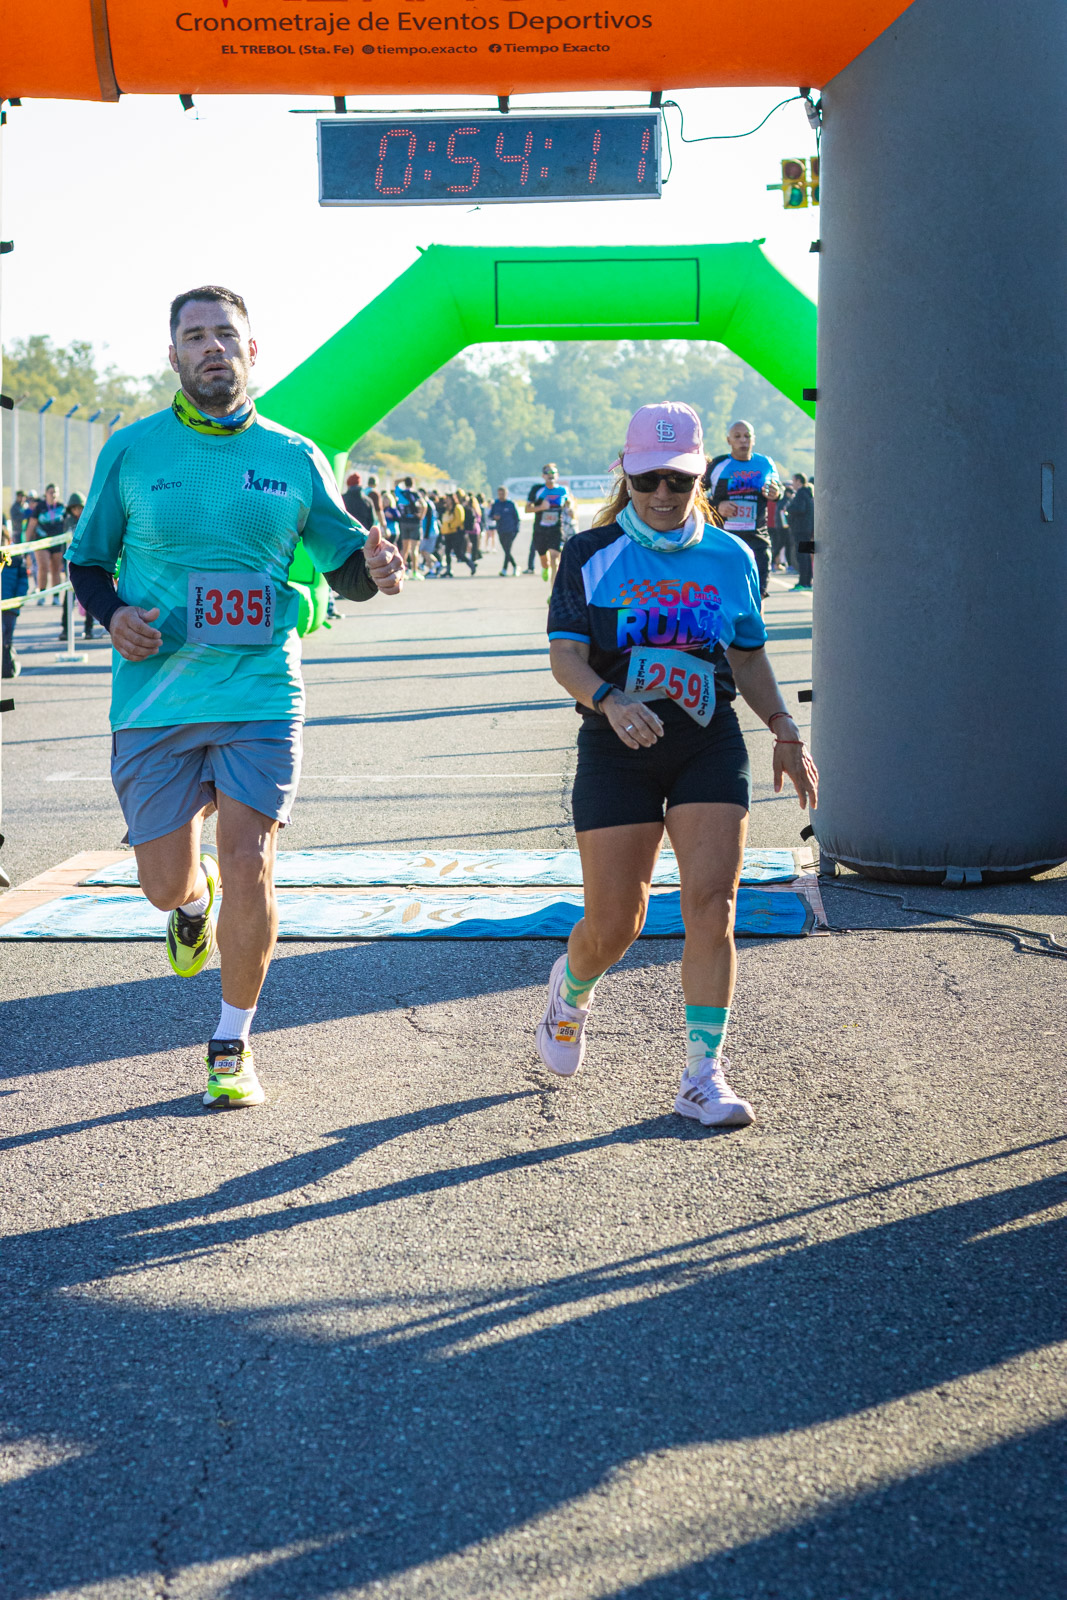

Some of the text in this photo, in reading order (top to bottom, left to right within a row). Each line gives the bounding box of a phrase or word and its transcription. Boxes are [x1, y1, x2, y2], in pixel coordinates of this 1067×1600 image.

[176, 11, 653, 36] Cronometraje de Eventos Deportivos
[221, 43, 610, 56] EL TREBOL (Sta. Fe) tiempo.exacto Tiempo Exacto
[374, 127, 650, 195] 0:54:11
[150, 481, 183, 491] INVICTO
[242, 469, 288, 492] km
[194, 586, 204, 629] TIEMPO
[205, 589, 264, 626] 335
[264, 585, 272, 628] EXACTO
[645, 662, 702, 708] 259
[697, 673, 711, 716] EXACTO
